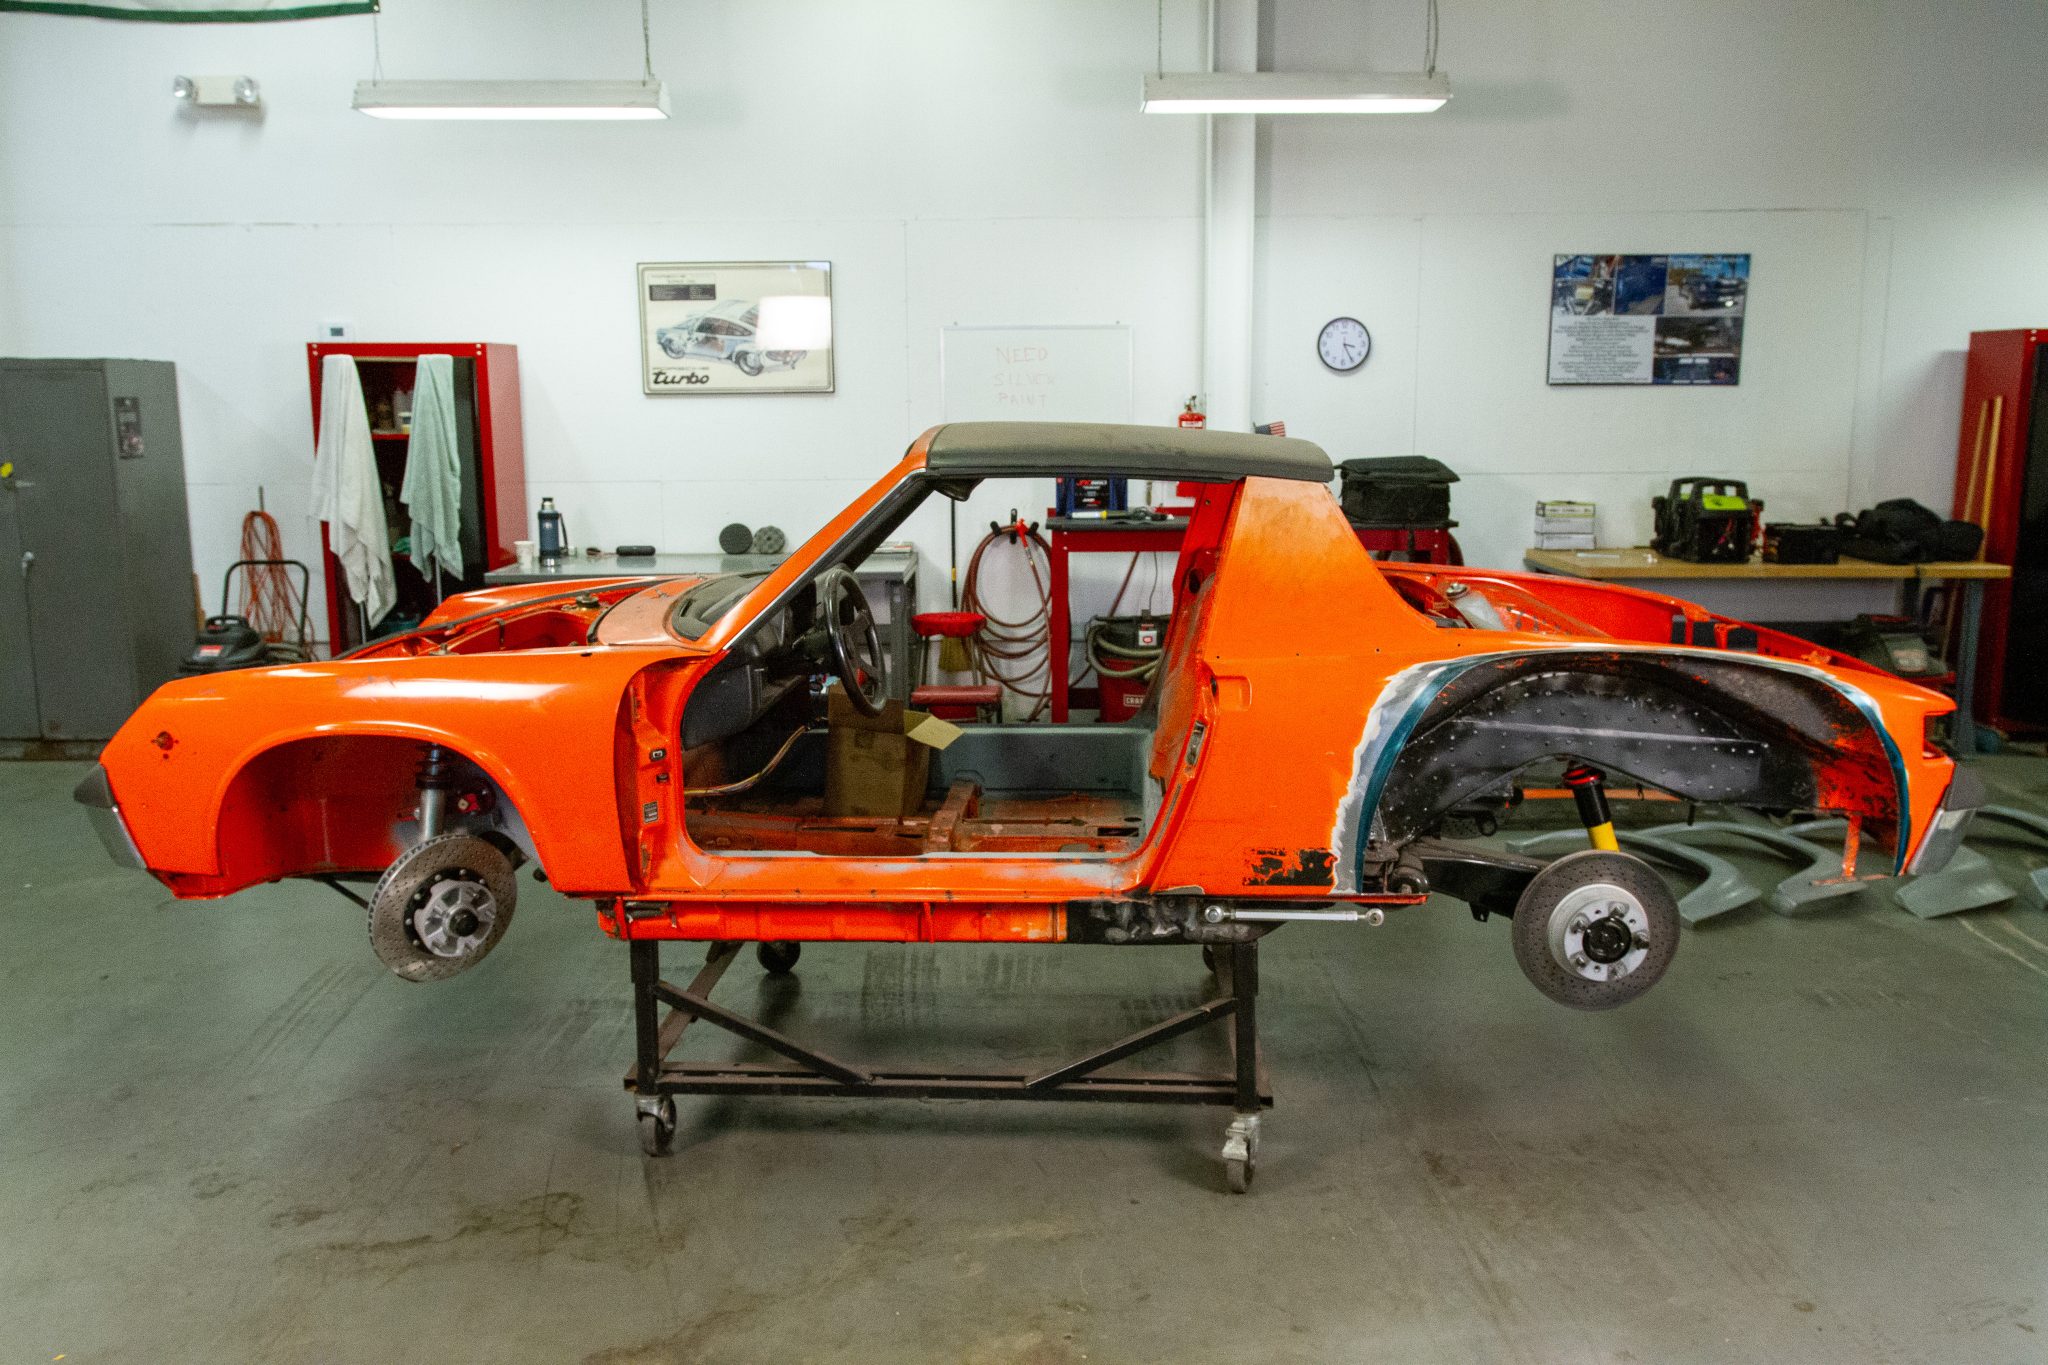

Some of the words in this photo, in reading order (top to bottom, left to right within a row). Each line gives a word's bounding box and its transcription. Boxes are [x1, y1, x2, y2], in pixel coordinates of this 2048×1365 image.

[996, 347, 1048, 364] NEED
[652, 370, 709, 384] turbo
[993, 372, 1056, 387] SILVER
[996, 391, 1047, 408] PAINT
